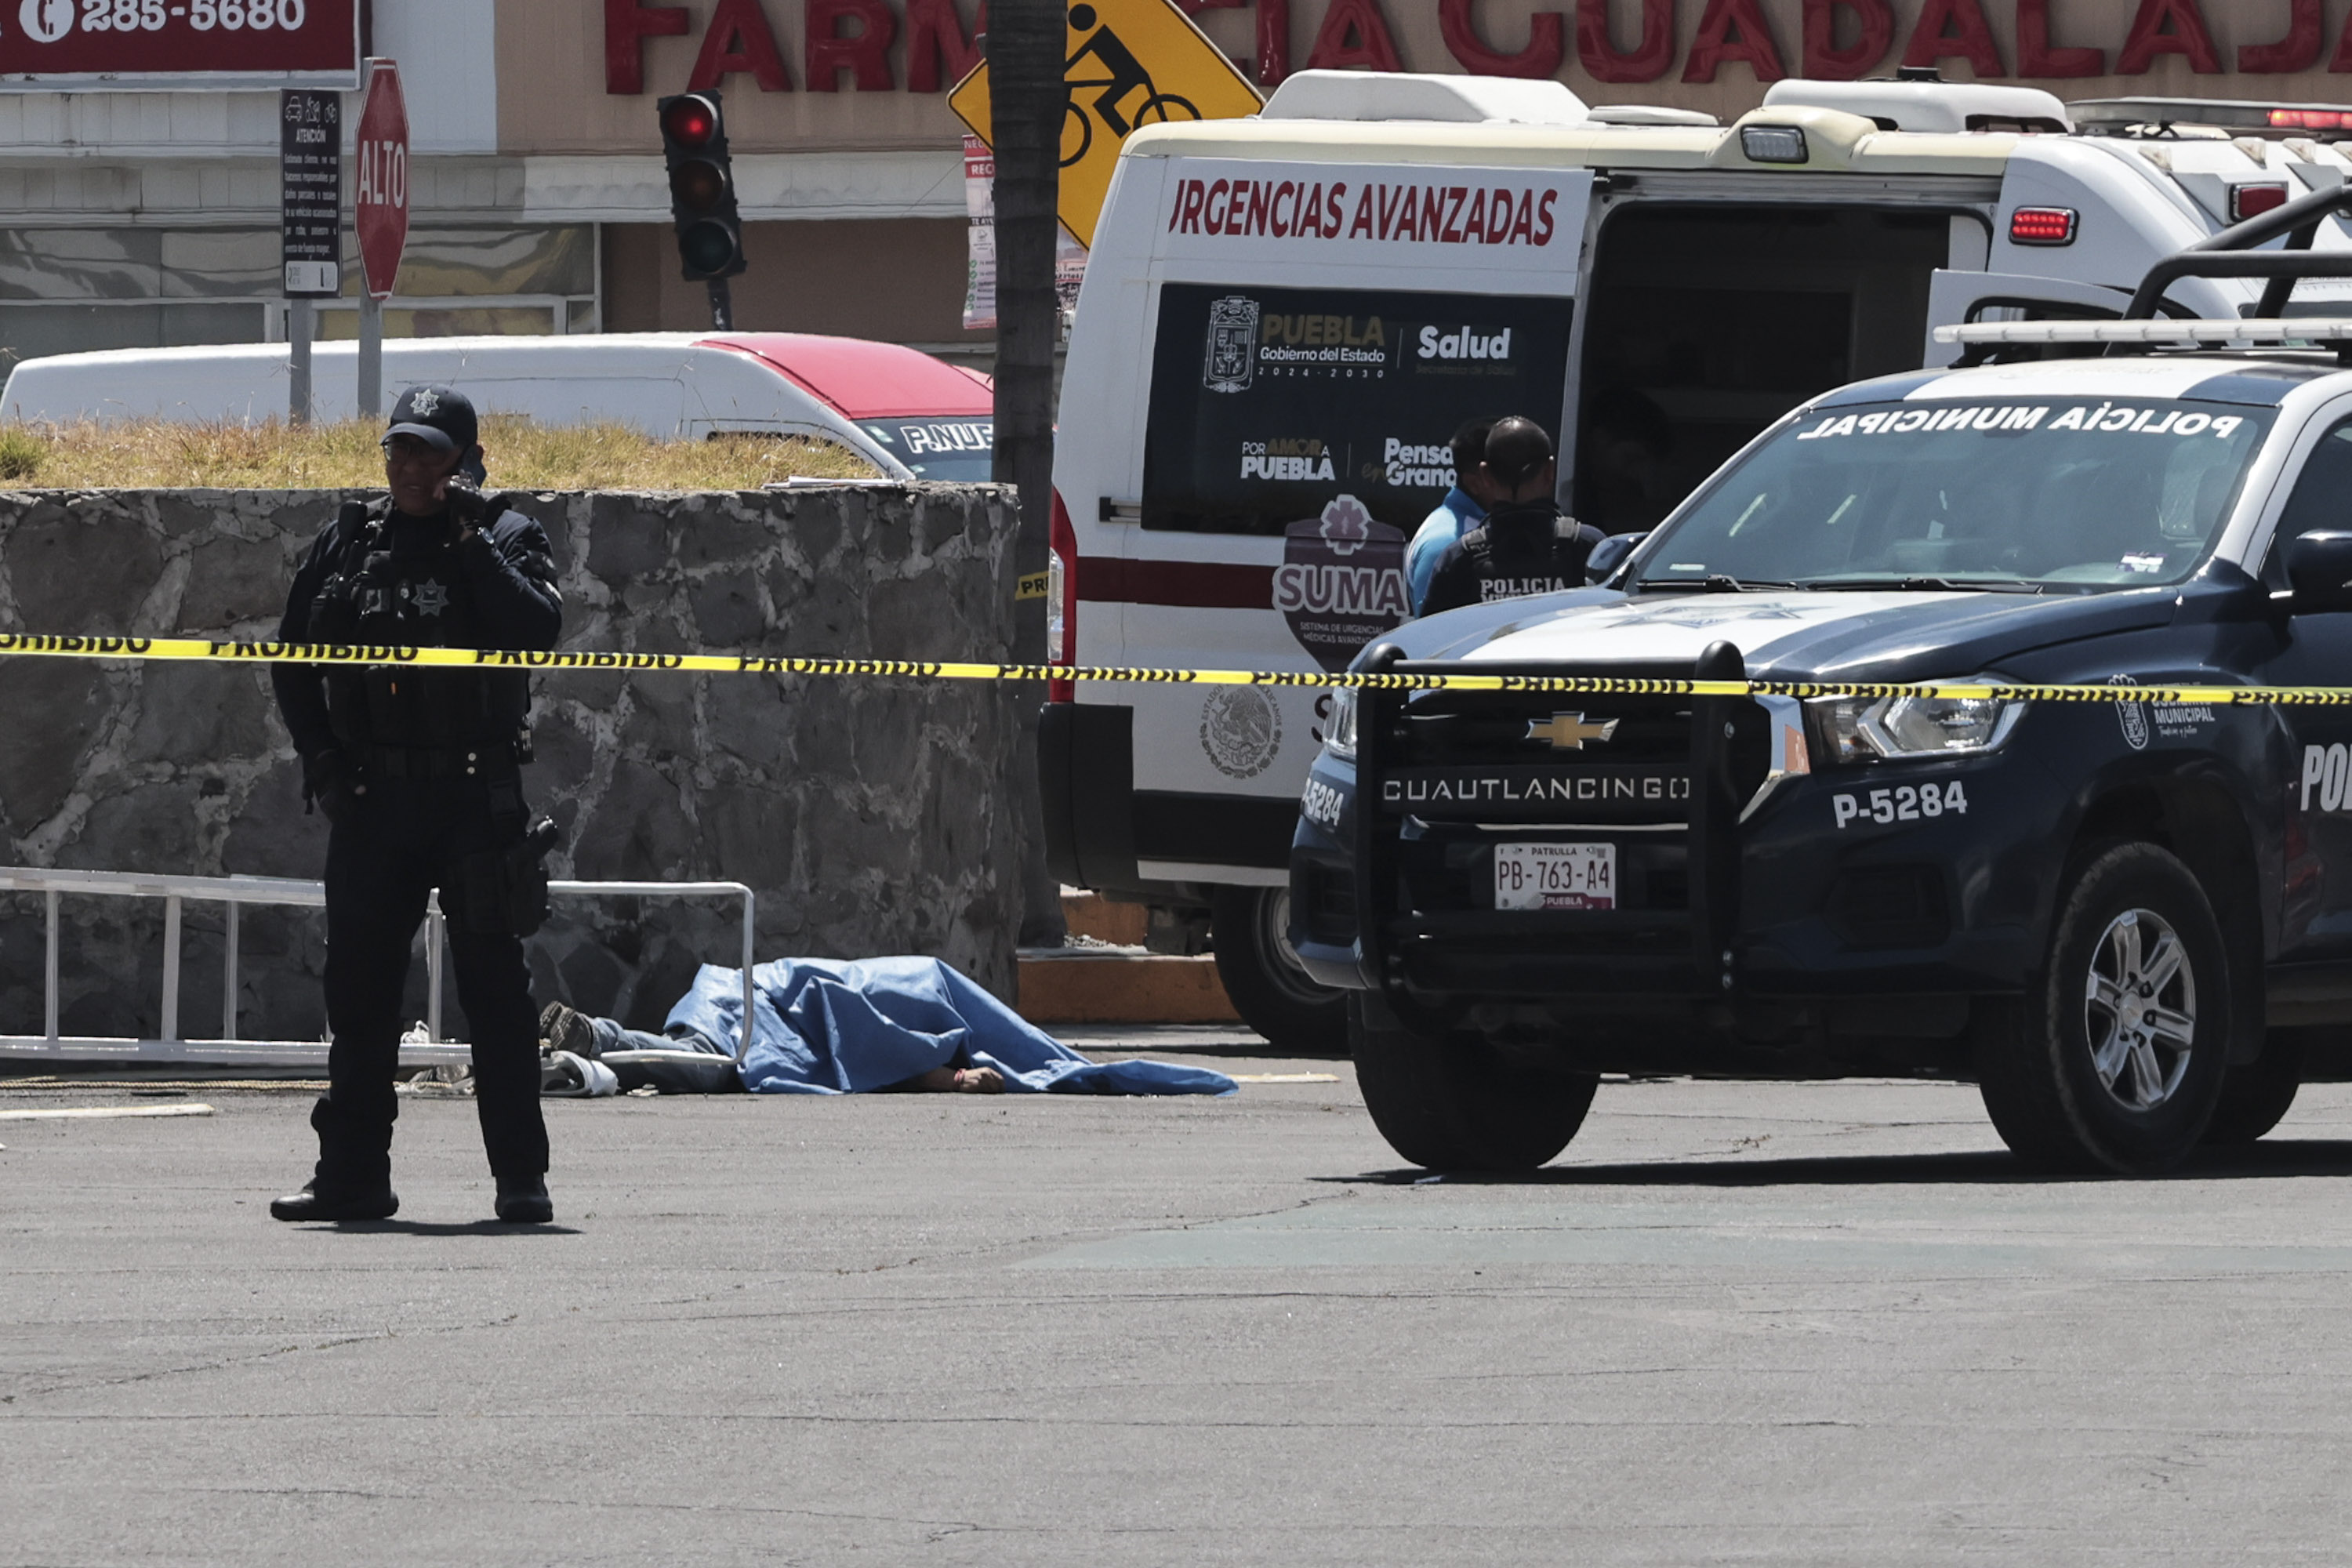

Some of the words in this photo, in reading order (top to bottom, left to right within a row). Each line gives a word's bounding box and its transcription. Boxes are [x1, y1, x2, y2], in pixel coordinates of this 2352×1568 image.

[82, 0, 305, 31] 285-5680
[1439, 0, 2352, 83] GUADALAJ
[296, 125, 326, 143] ATENCIÓN
[358, 140, 406, 209] ALTO
[971, 163, 995, 175] REC
[1348, 183, 1558, 246] AVANZADAS
[1261, 314, 1385, 347] PUEBLA
[1417, 325, 1512, 359] Salud
[1260, 346, 1318, 361] Gobierno
[1319, 347, 1338, 361] del
[1341, 347, 1385, 362] Estado
[1242, 441, 1265, 455] POR
[1267, 438, 1323, 455] AMOR
[1321, 445, 1330, 456] A
[1240, 456, 1336, 481] PUEBLA
[1276, 566, 1408, 614] SUMA
[1480, 577, 1566, 594] POLICIA
[1300, 622, 1329, 632] SISTEMA
[1331, 623, 1340, 632] DE
[1342, 624, 1385, 635] URGENCIAS
[1303, 633, 1336, 643] MÉDICAS
[2154, 707, 2216, 724] MUNICIPAL
[1384, 778, 1690, 800] CUAUTLANCINGO
[1833, 781, 1968, 829] P-5284
[1499, 861, 1609, 890] PB-763-A4
